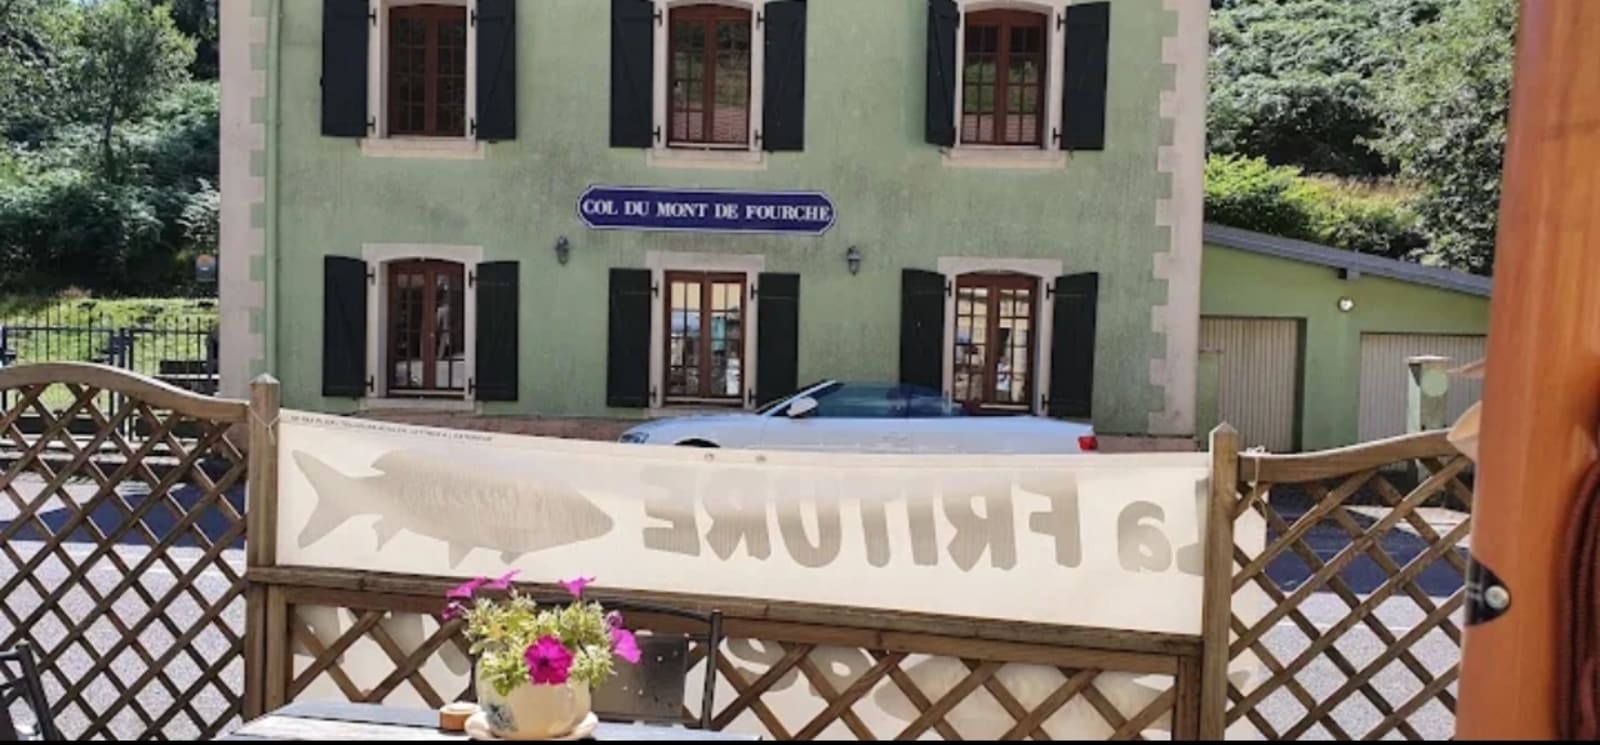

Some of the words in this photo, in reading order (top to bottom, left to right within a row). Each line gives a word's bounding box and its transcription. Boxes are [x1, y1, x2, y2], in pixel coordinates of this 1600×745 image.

[582, 199, 618, 216] COL
[624, 201, 650, 217] DU
[656, 202, 709, 218] MONT
[714, 203, 739, 220] DE
[745, 205, 831, 222] FOURCHE
